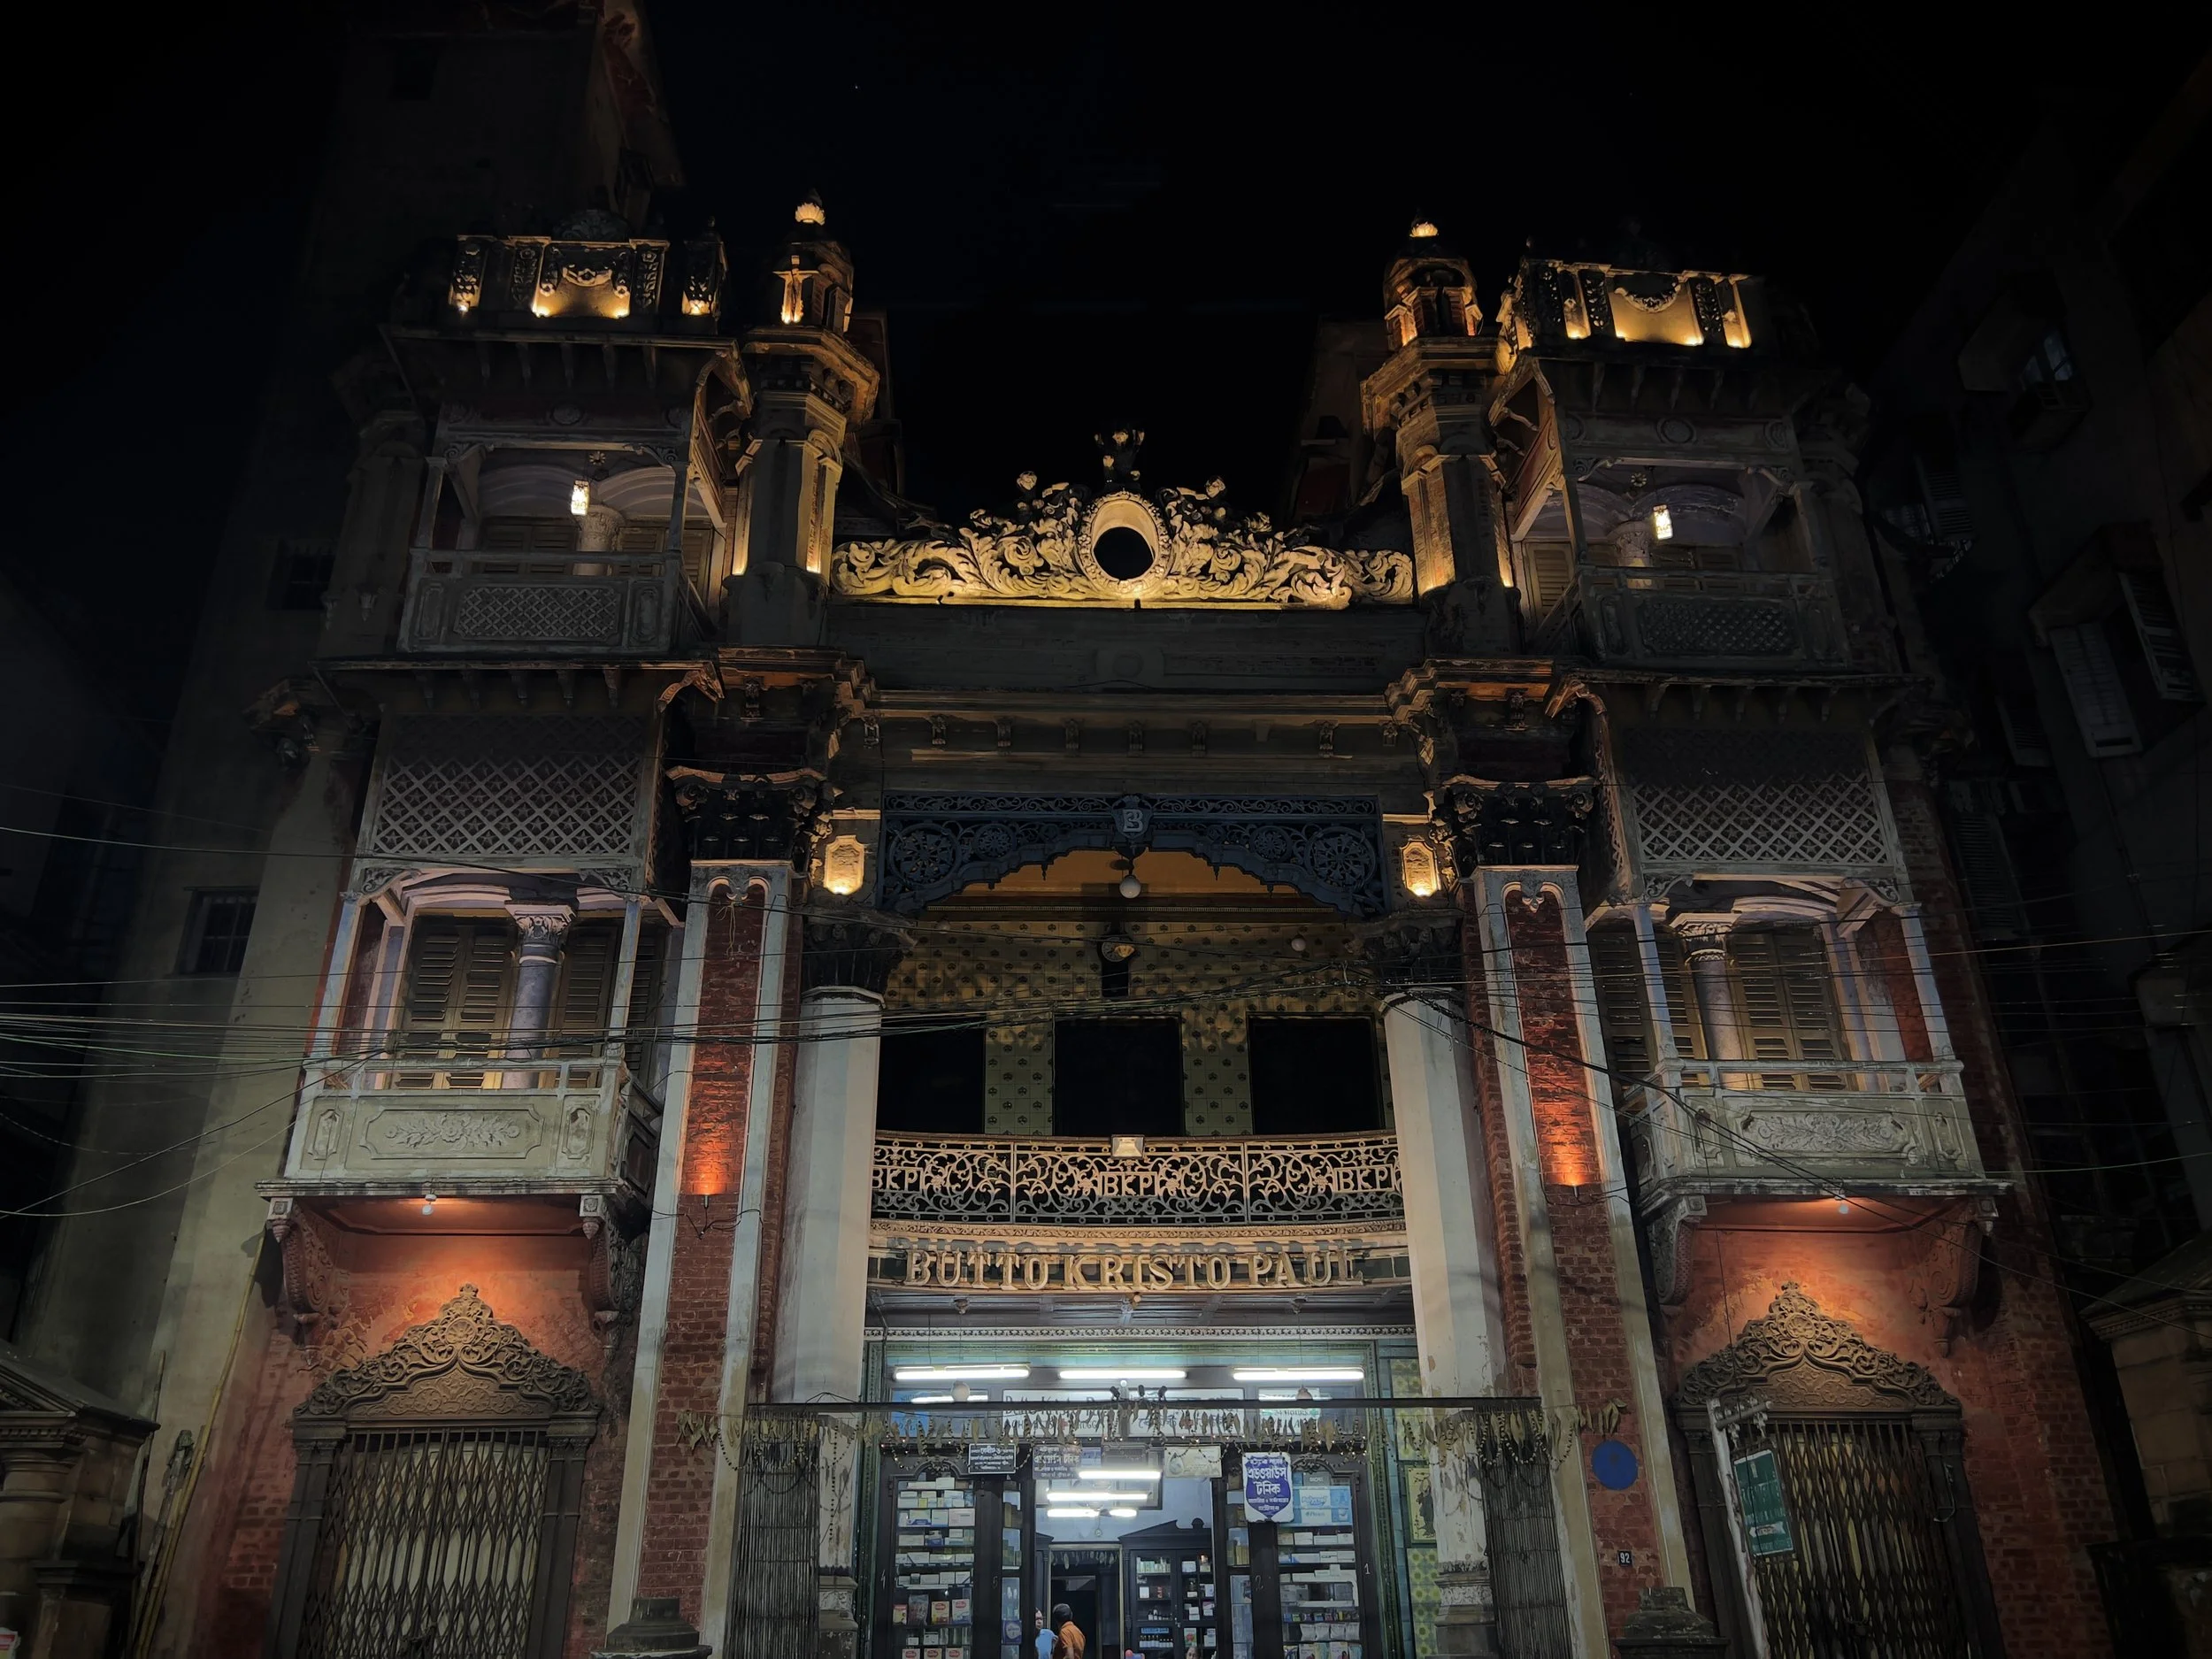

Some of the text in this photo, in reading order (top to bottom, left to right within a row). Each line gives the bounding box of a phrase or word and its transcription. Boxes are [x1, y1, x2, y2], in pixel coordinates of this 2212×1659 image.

[1103, 1173, 1153, 1195] BKP
[1338, 1167, 1388, 1191] BKP
[905, 1248, 1366, 1291] BUTTO KRISTO PAUL
[1253, 1480, 1281, 1495] টনিক
[1620, 1552, 1631, 1563] 92
